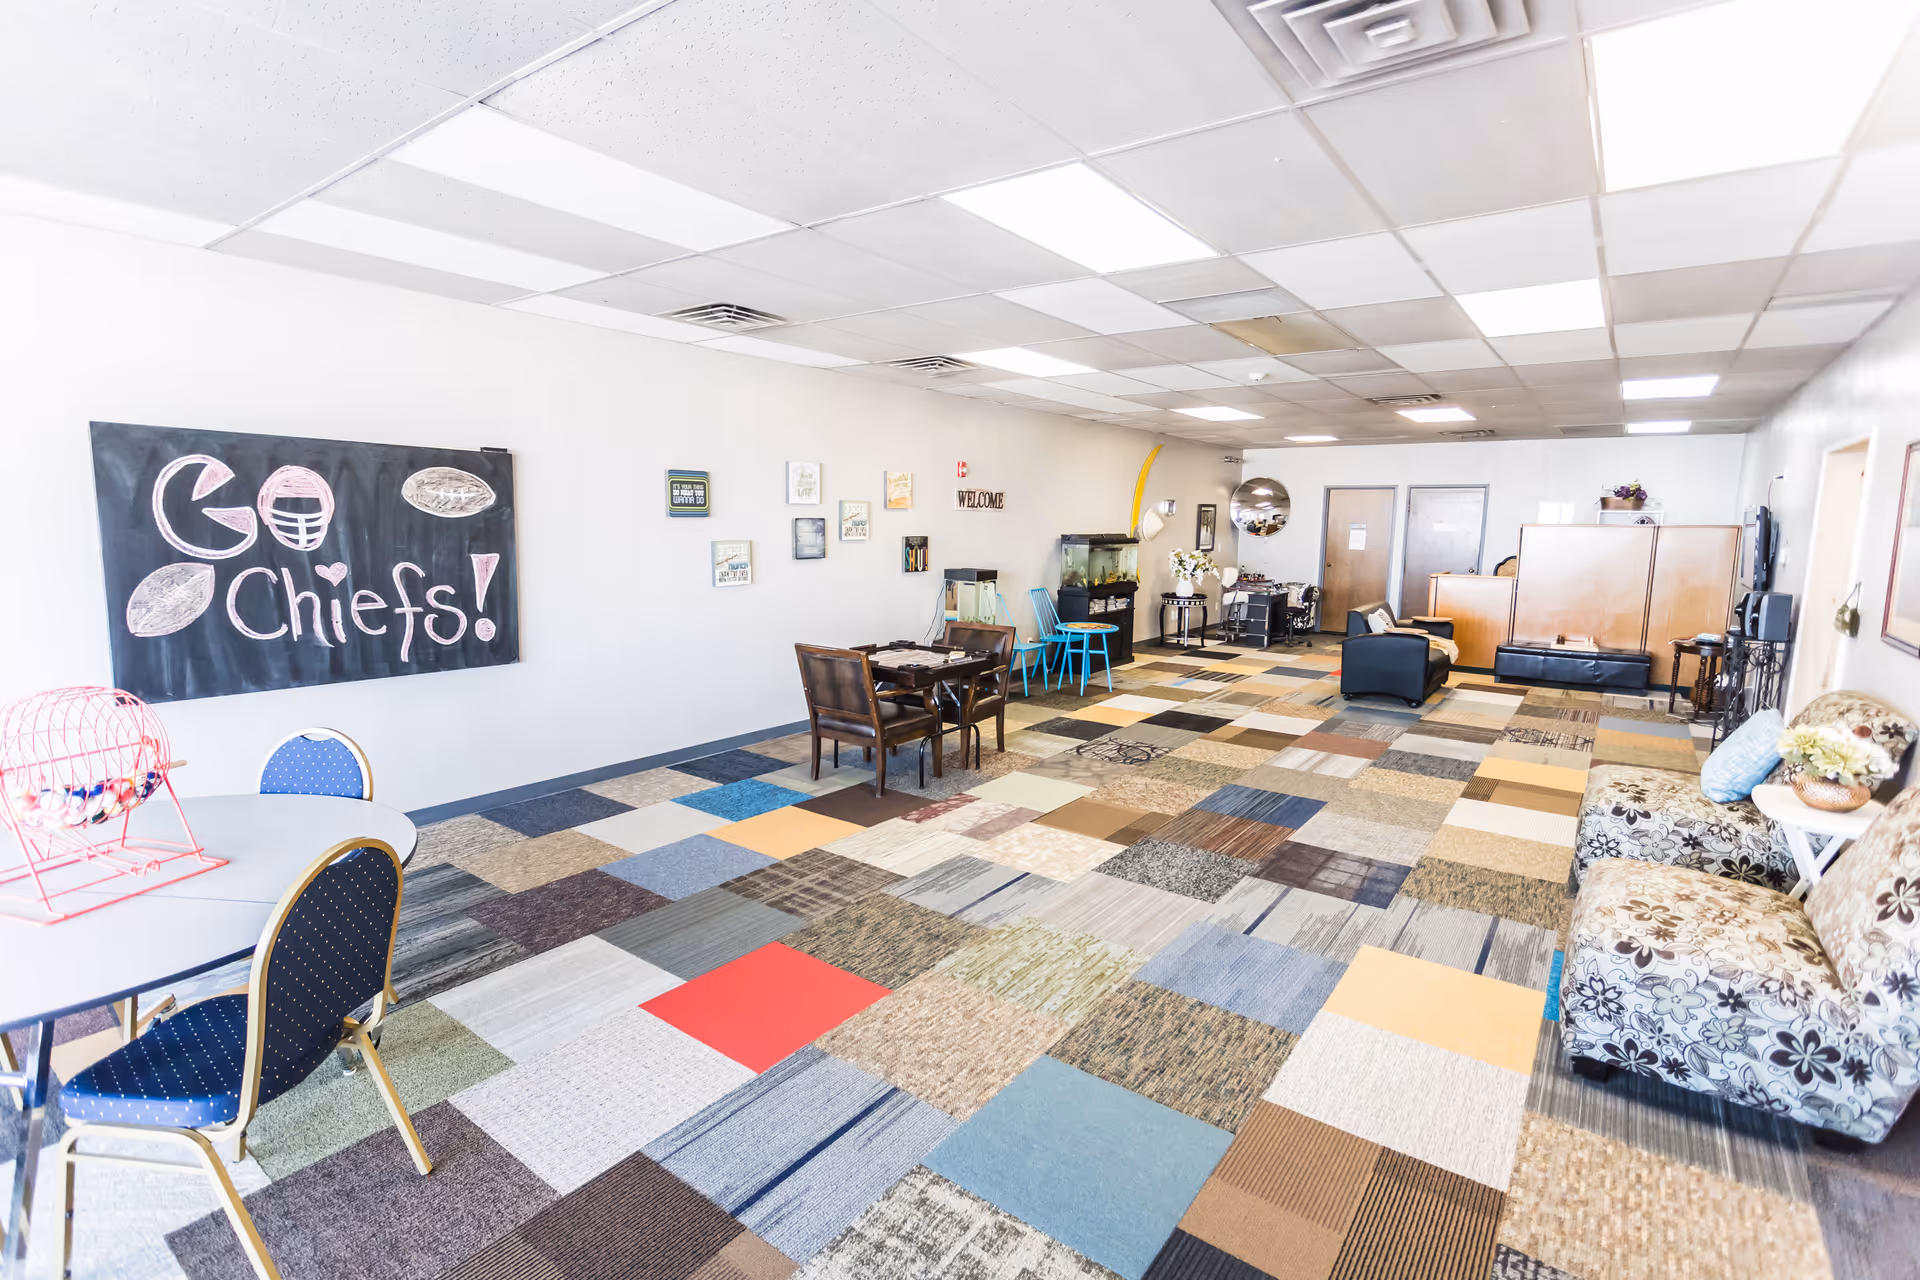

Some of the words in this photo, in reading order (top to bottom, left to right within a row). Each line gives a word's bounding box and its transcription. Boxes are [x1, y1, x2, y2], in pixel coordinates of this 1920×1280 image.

[673, 496, 695, 504] WANNA
[957, 490, 1004, 509] WELCOME
[226, 553, 500, 662] Chiefs!
